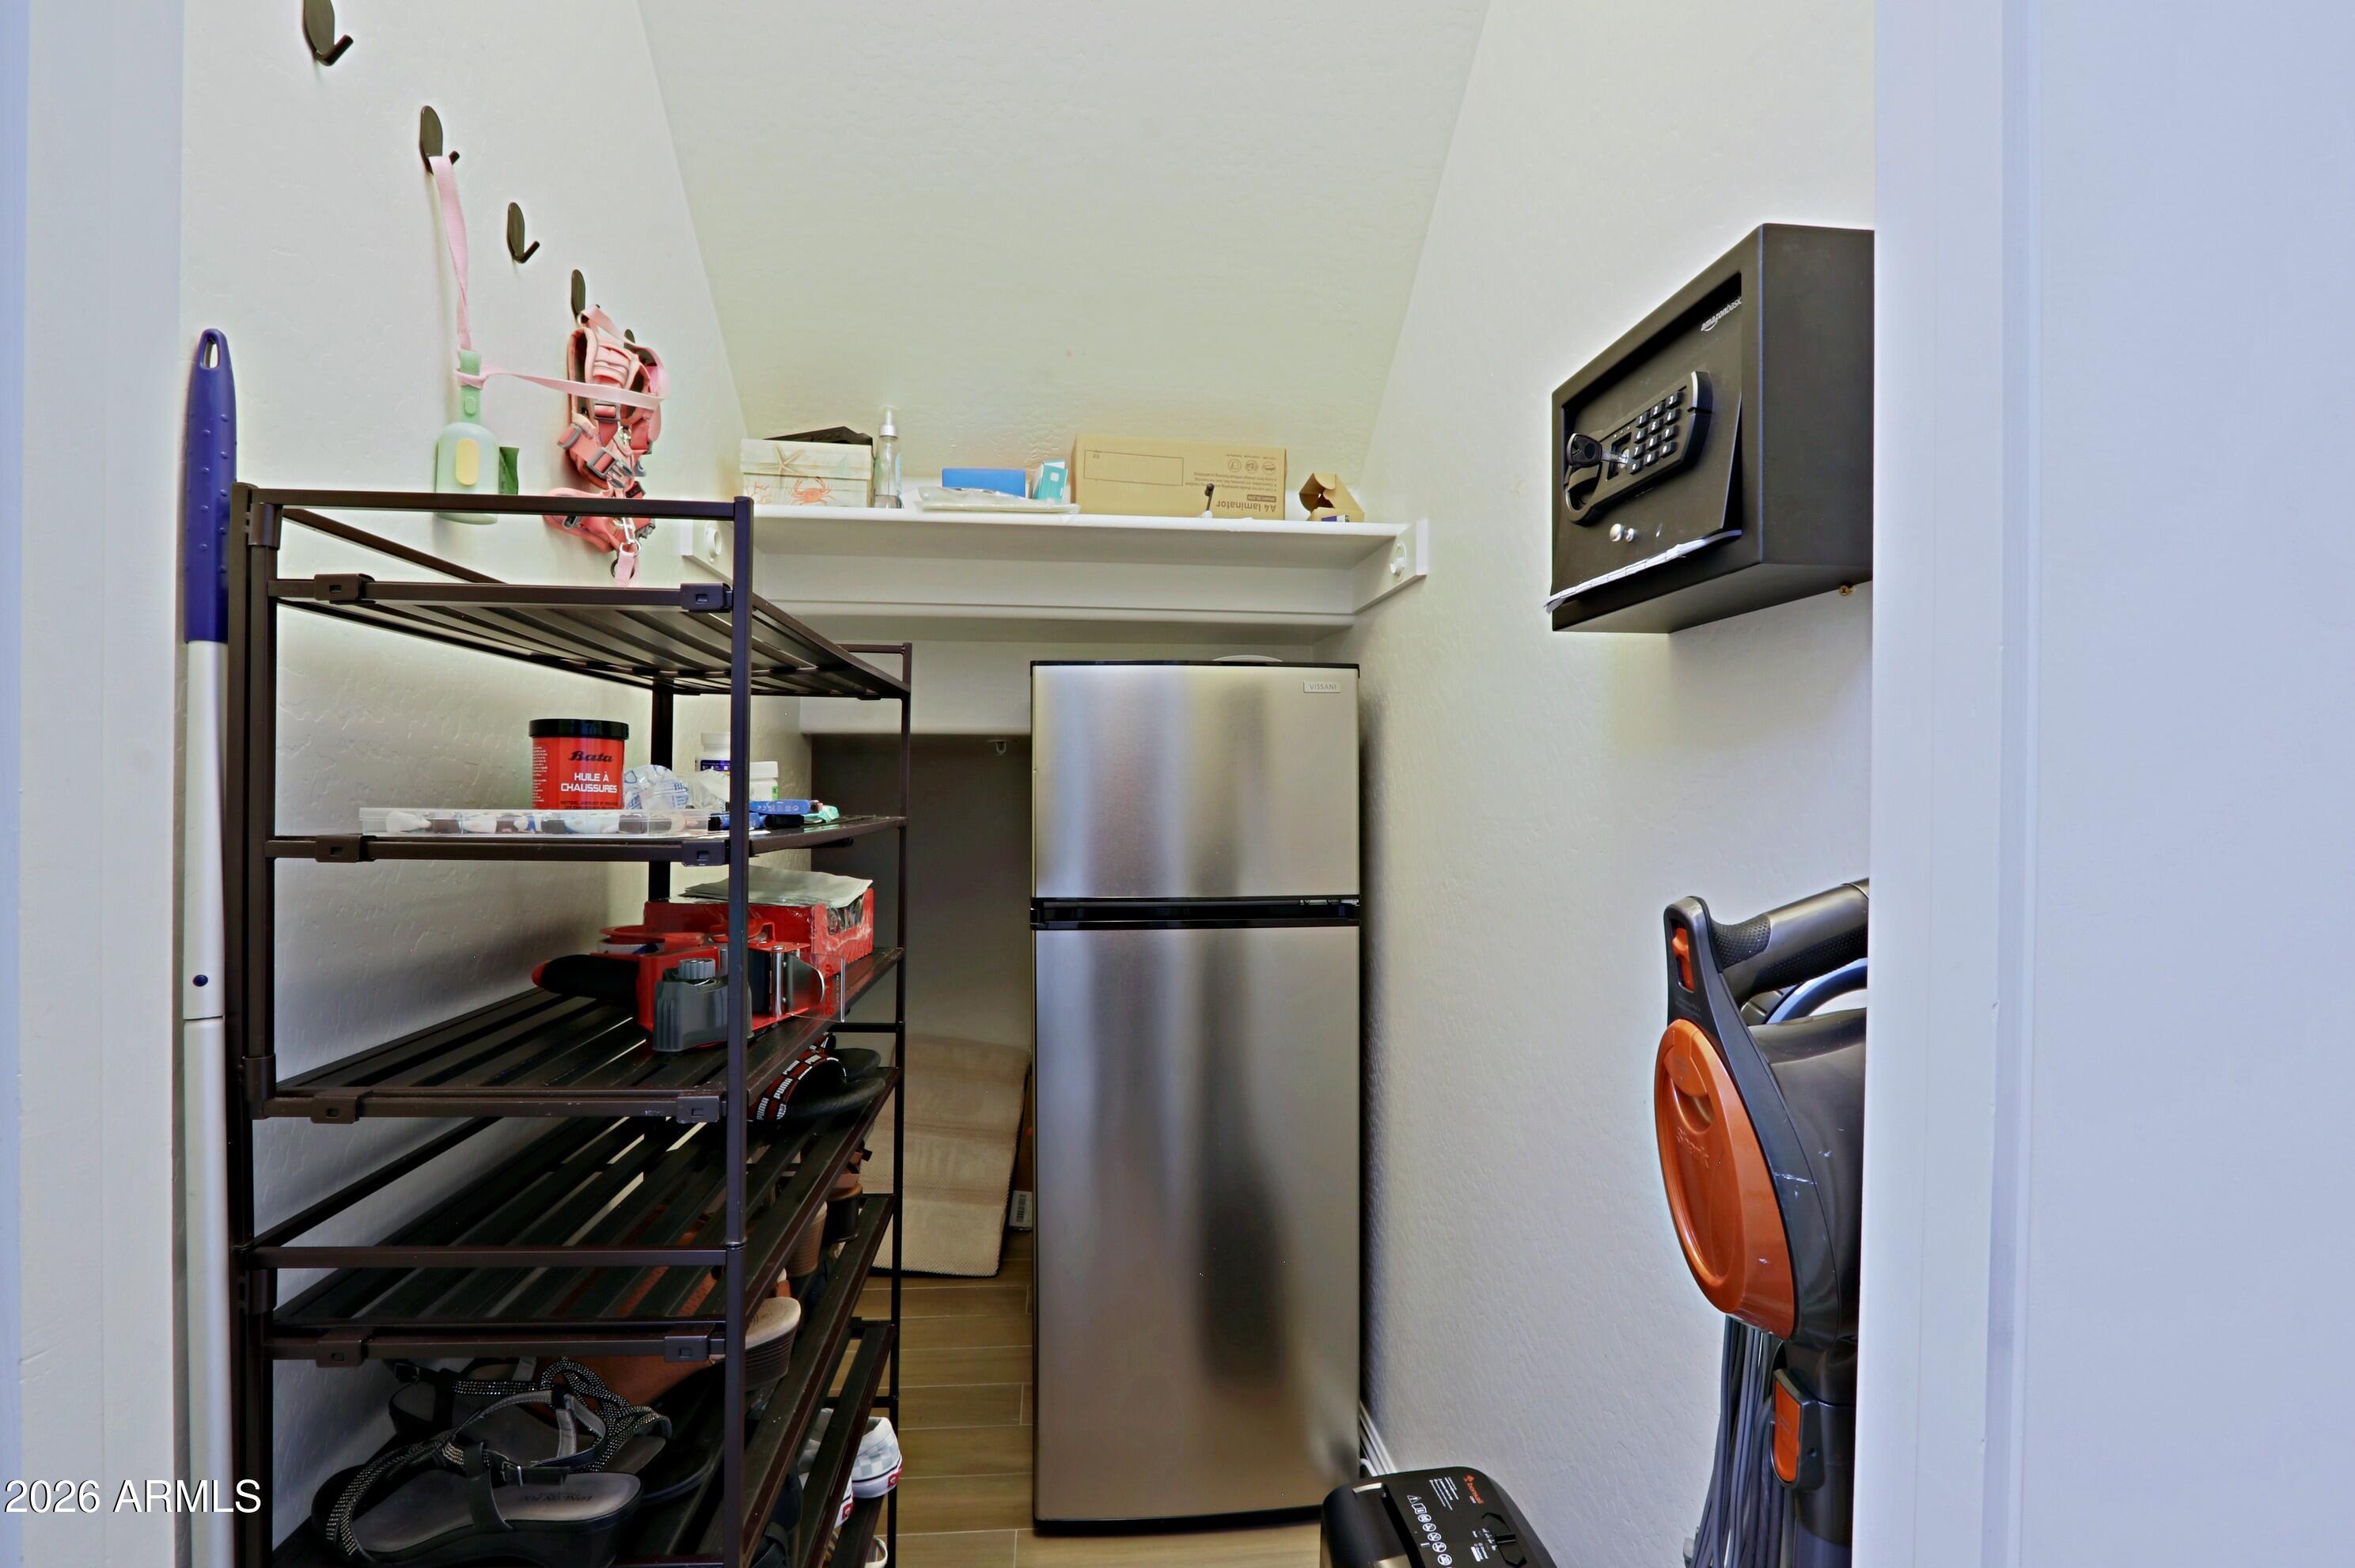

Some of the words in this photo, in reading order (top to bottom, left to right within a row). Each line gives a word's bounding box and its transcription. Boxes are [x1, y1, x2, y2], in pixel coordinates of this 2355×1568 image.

[1701, 296, 1743, 331] amazonbasic
[1216, 501, 1261, 512] laminator
[1265, 504, 1276, 513] A4
[568, 750, 614, 763] Bata
[574, 772, 600, 782] HUILE
[603, 771, 609, 782] À
[560, 782, 617, 793] CHAUSSURES
[773, 1078, 793, 1100] PUMA
[756, 1096, 769, 1121] PUMA
